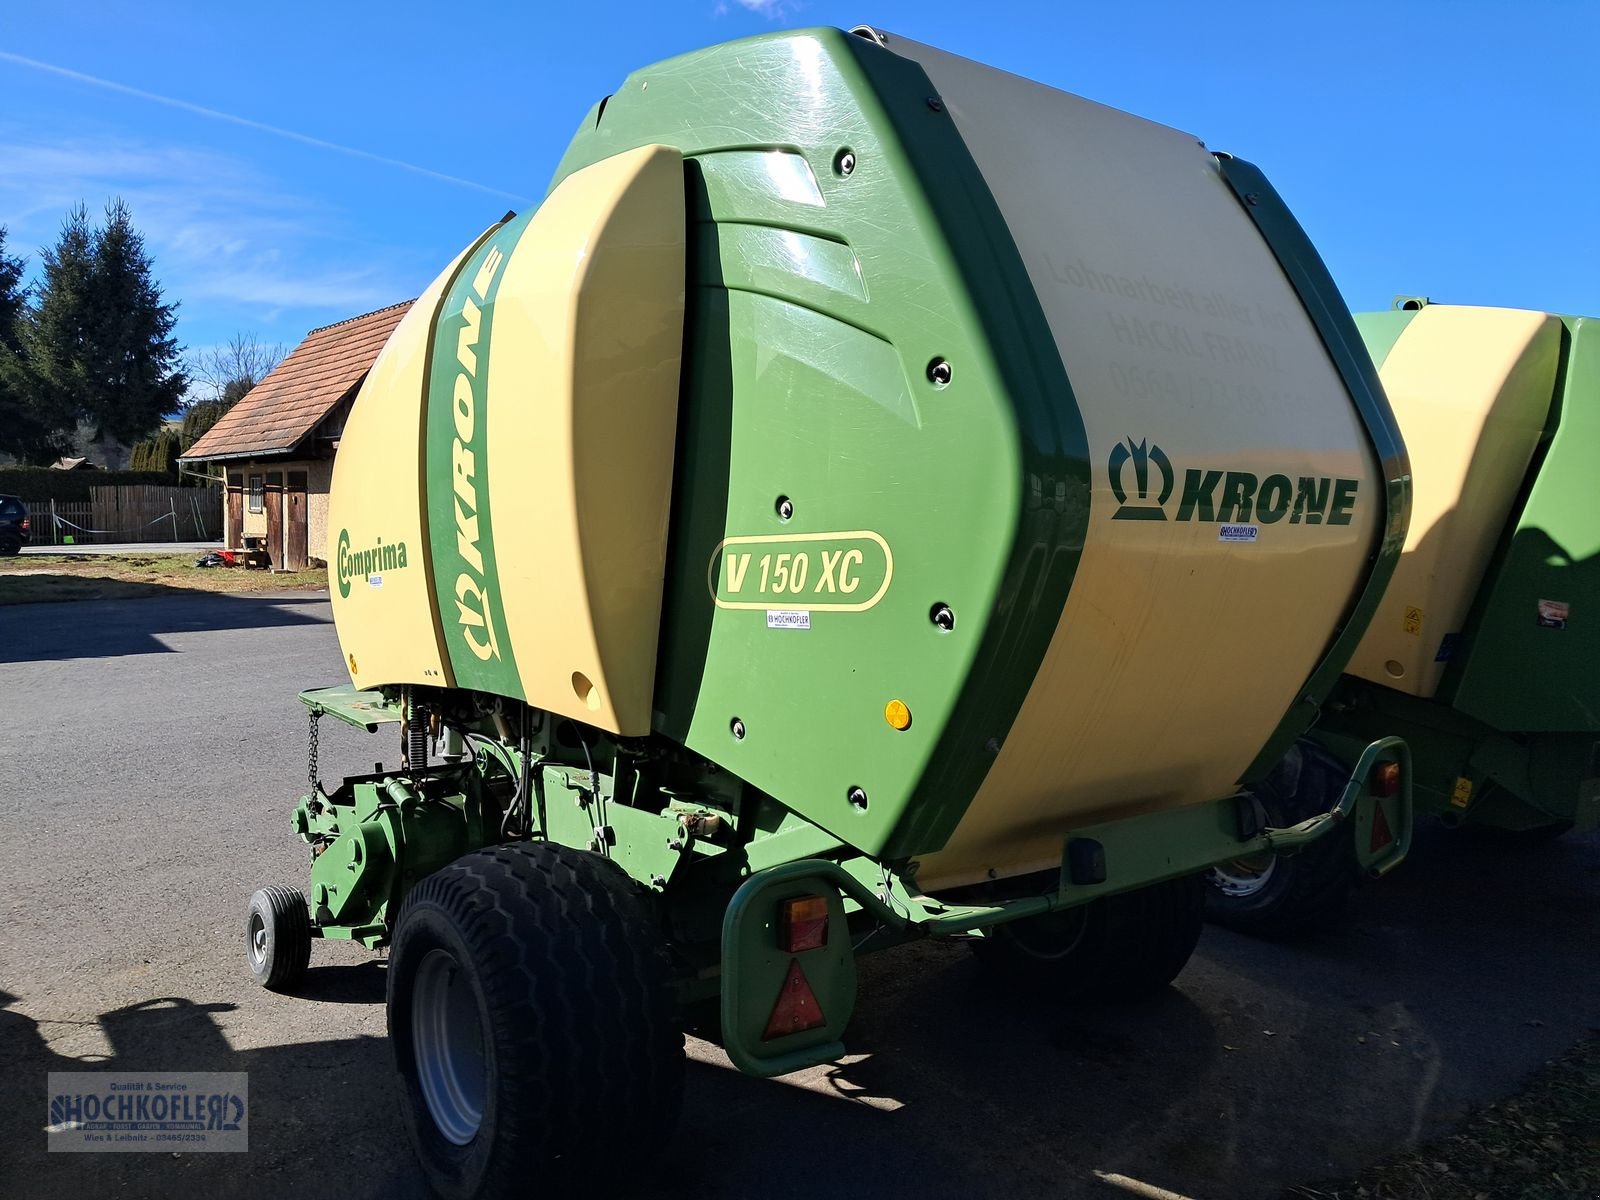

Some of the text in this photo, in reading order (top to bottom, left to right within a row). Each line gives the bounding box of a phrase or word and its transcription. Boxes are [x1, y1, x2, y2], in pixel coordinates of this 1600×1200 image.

[1041, 251, 1200, 313] Lohnarbeit
[452, 244, 503, 577] KRONE
[1176, 468, 1359, 526] KRONE
[337, 528, 408, 598] Comprima
[726, 548, 863, 594] V 150 XC
[774, 615, 809, 624] HOCHKOFLER
